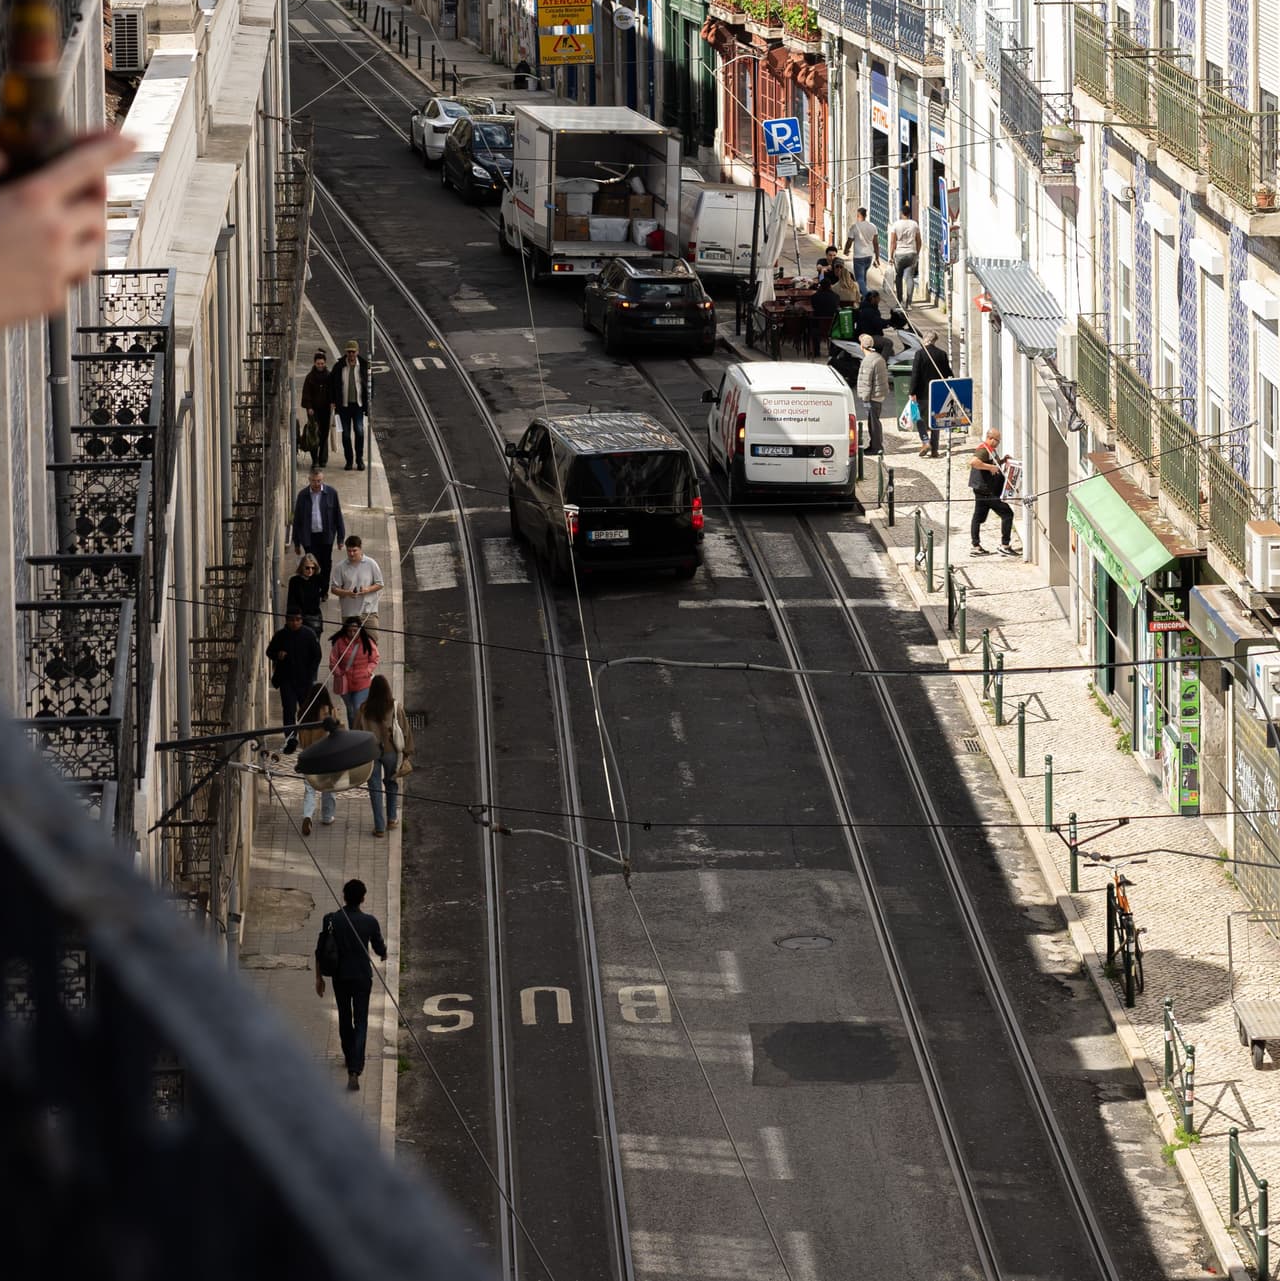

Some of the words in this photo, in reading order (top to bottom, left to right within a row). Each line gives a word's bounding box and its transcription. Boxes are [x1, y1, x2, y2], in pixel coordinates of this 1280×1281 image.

[873, 106, 888, 129] STIHL
[770, 122, 792, 151] P
[762, 398, 773, 406] De
[791, 398, 832, 407] encomenda
[788, 408, 809, 416] quiser
[812, 467, 827, 476] ctt
[422, 985, 672, 1033] BUS
